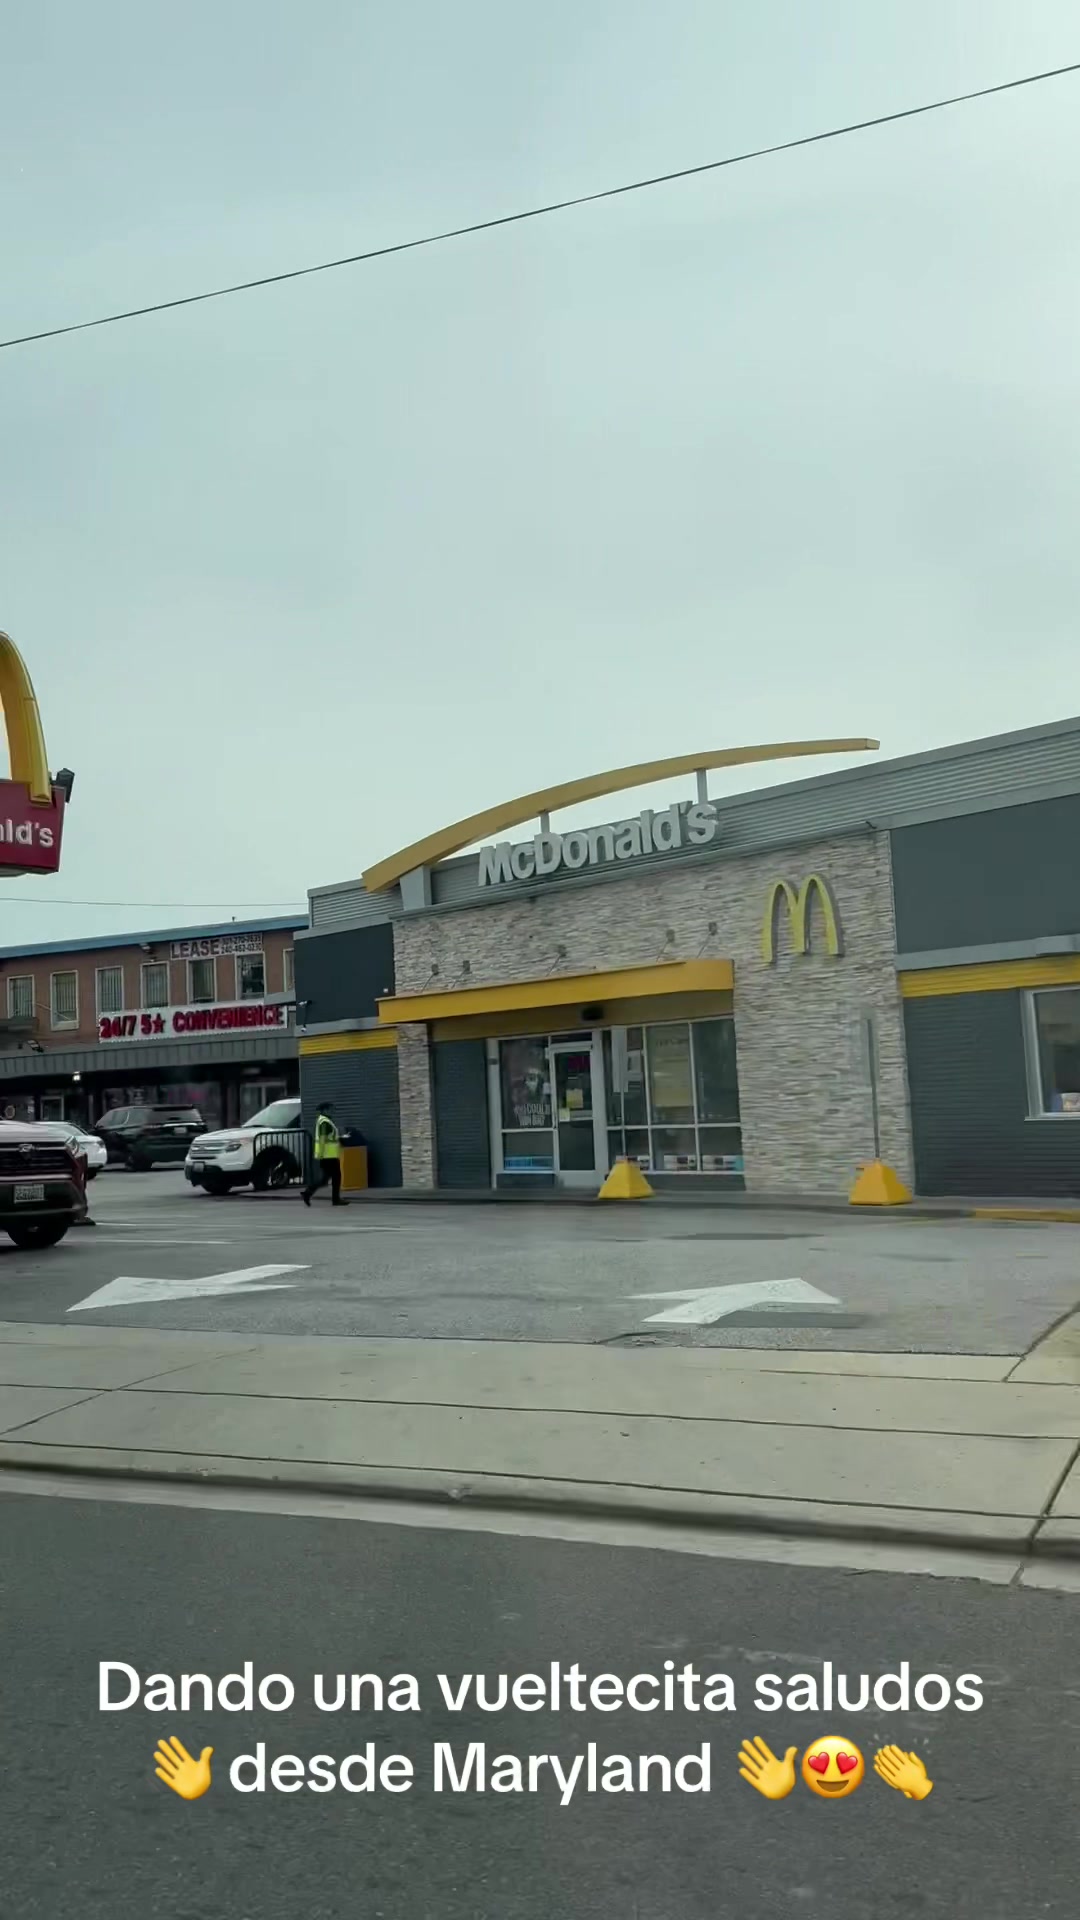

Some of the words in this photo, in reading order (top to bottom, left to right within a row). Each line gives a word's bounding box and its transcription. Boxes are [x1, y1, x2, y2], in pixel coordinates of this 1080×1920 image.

[478, 800, 719, 886] McDonald's
[172, 939, 220, 959] LEASE
[100, 1015, 137, 1038] 24/7
[173, 1004, 284, 1033] CONVENIENCE
